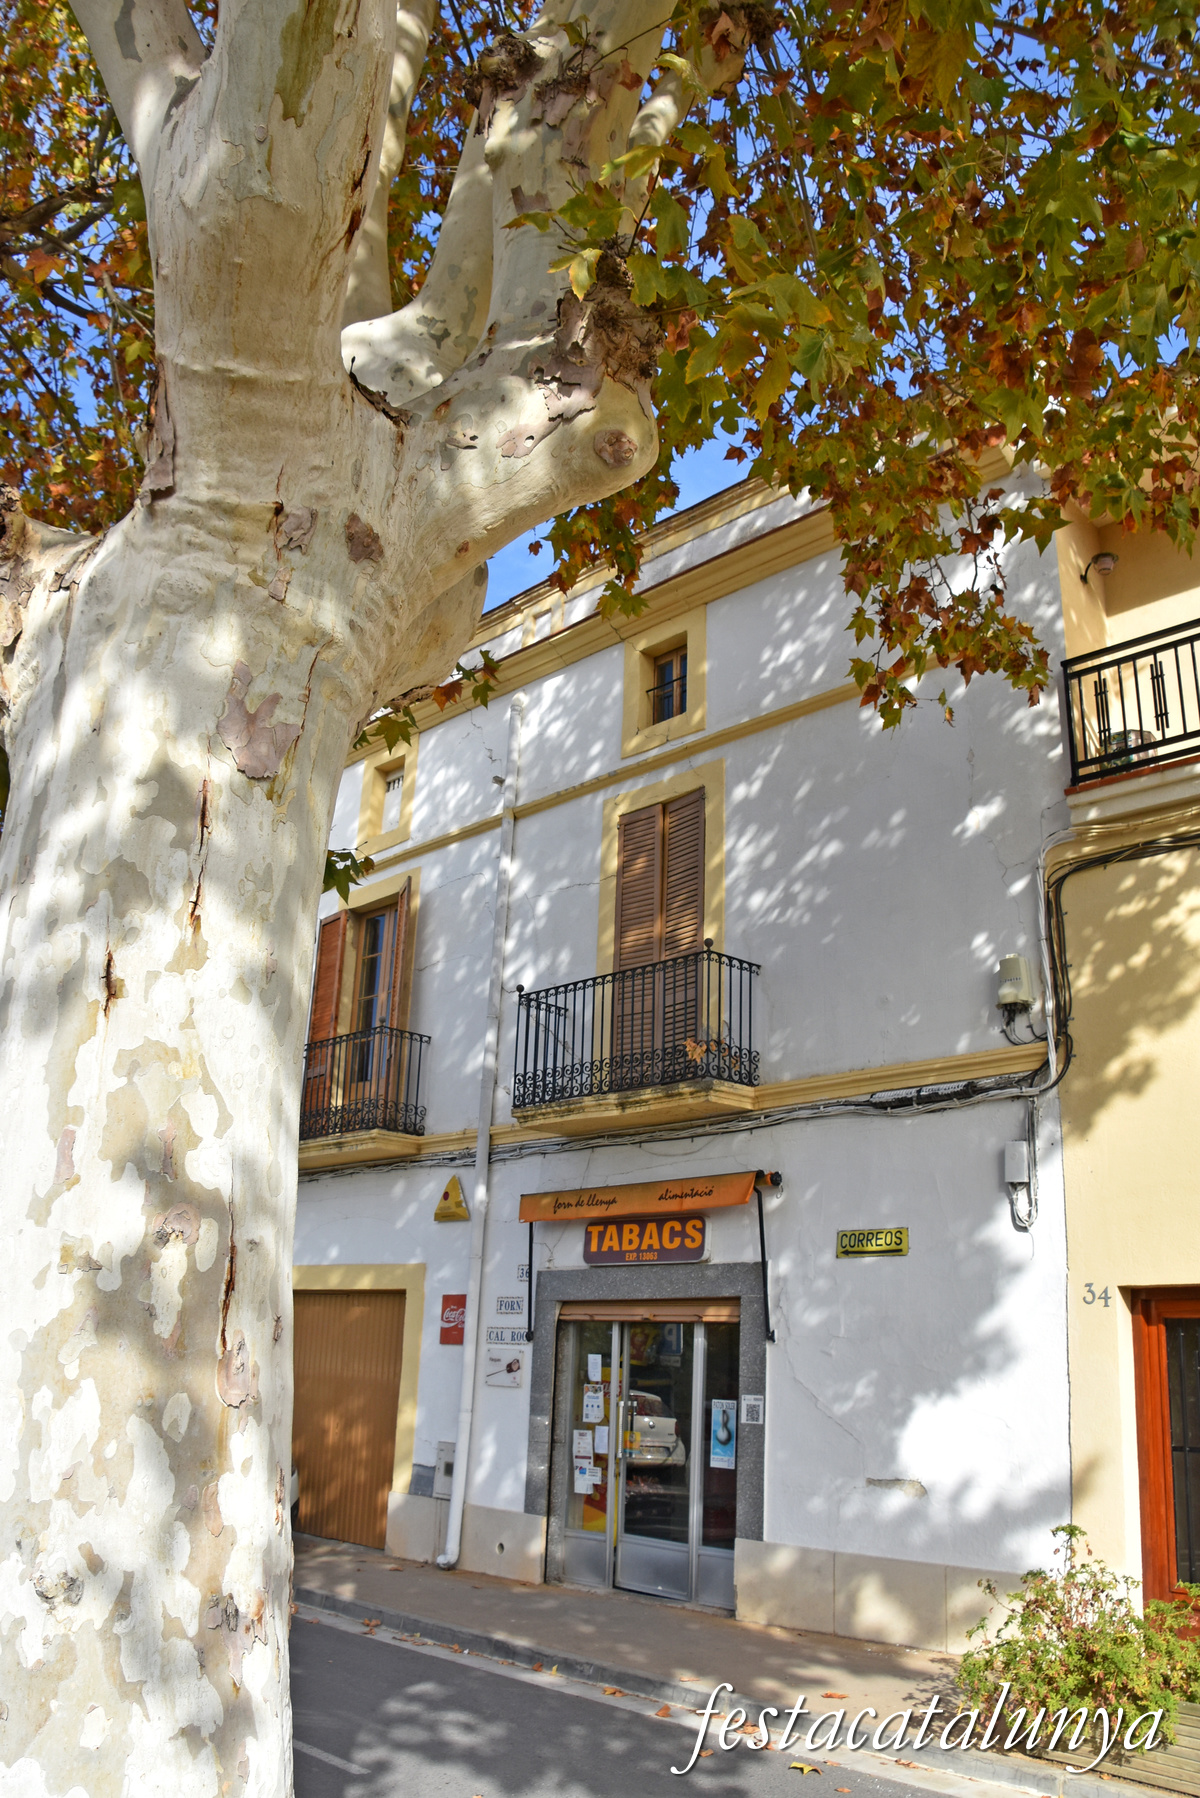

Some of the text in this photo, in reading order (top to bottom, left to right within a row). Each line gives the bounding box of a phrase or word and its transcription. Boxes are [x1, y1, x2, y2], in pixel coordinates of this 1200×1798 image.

[658, 1185, 715, 1201] alimentació
[553, 1193, 617, 1214] forn de llenya
[587, 1219, 703, 1252] TABACS
[840, 1230, 903, 1249] CORREOS
[625, 1252, 638, 1261] EXP.
[519, 1268, 530, 1279] 36
[1082, 1282, 1112, 1308] 34
[499, 1300, 521, 1311] FORN
[489, 1331, 505, 1342] CAL
